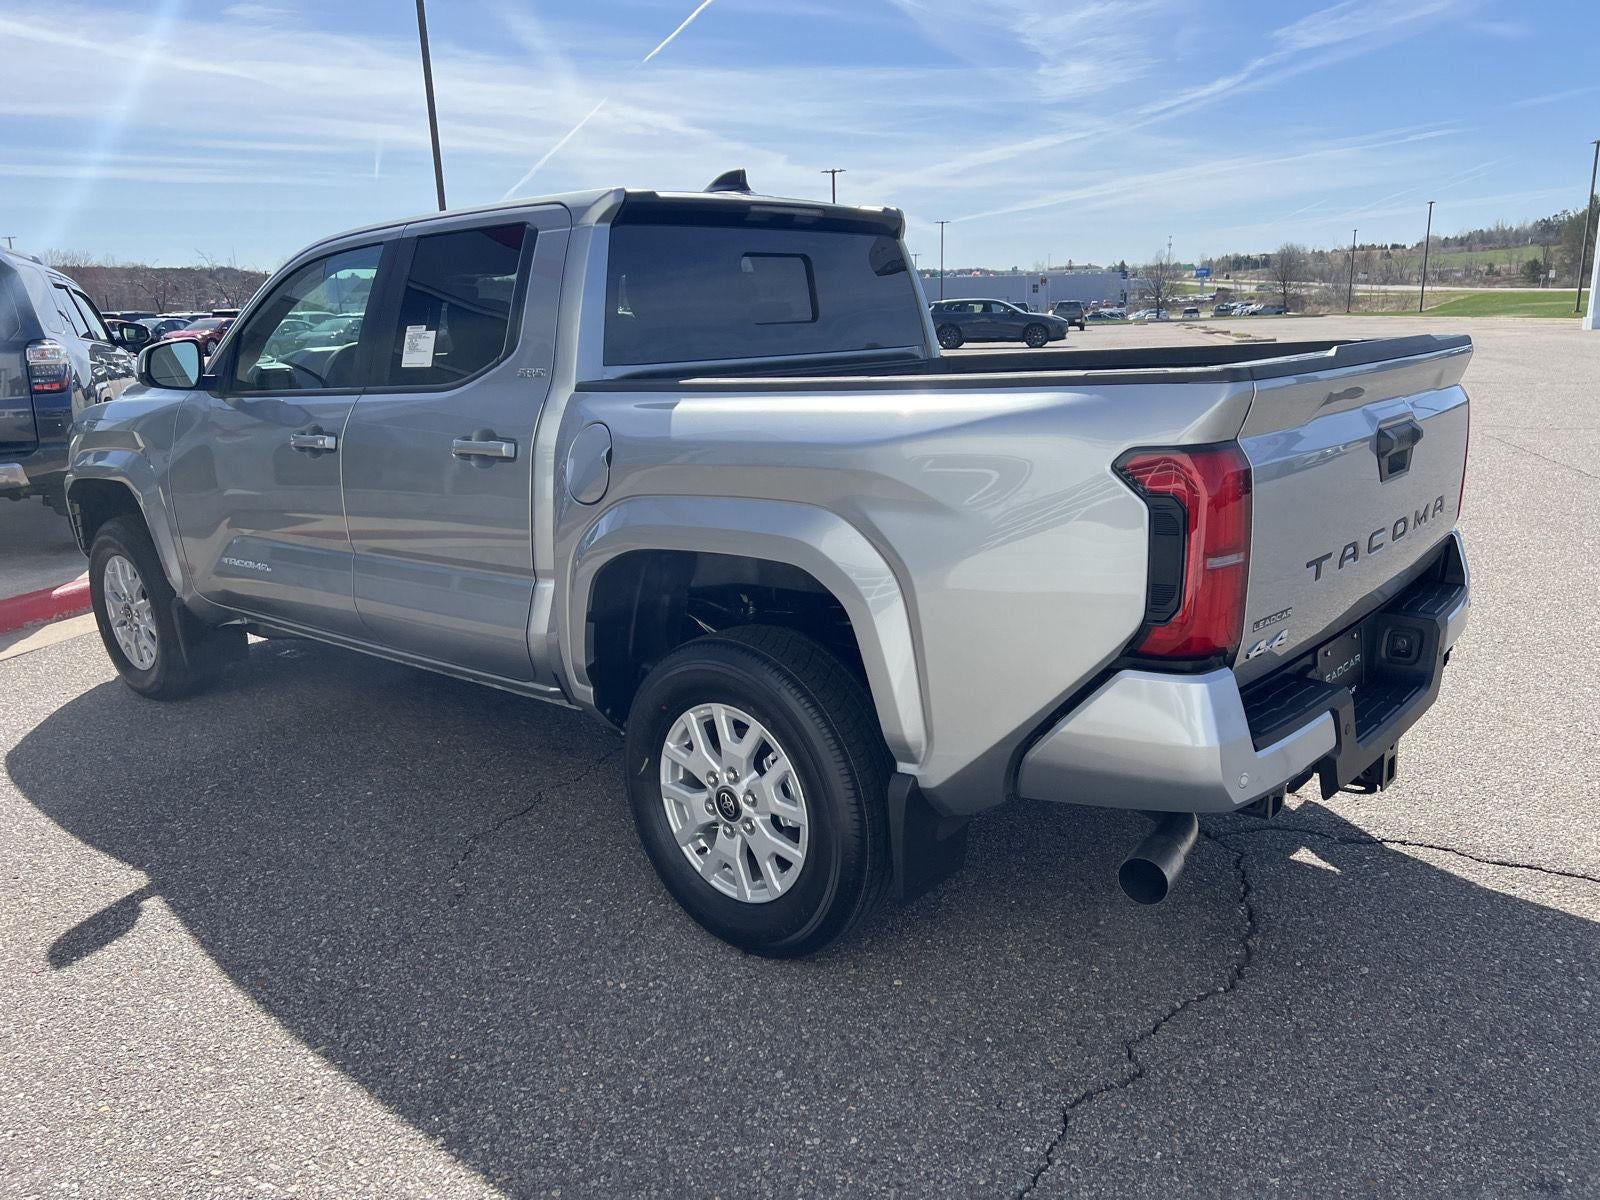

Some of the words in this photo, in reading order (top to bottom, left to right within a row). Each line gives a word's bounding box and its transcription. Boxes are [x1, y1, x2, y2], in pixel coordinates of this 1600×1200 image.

[1305, 495, 1445, 582] TACOMA
[1253, 608, 1294, 631] LEADCAR
[1325, 653, 1361, 684] EADCAR
